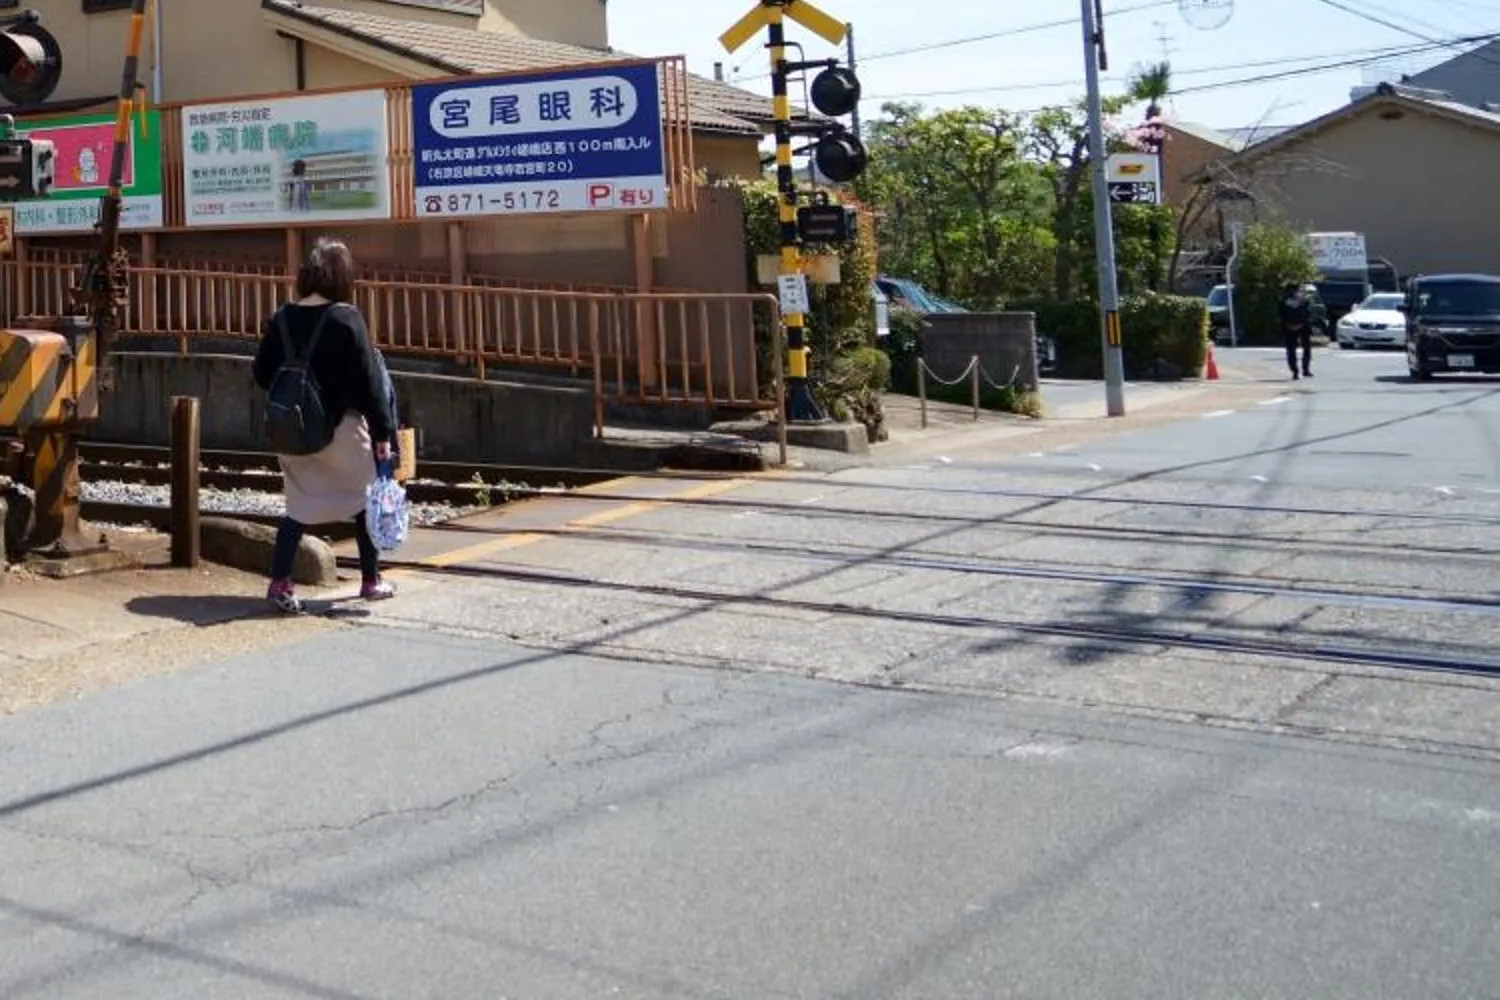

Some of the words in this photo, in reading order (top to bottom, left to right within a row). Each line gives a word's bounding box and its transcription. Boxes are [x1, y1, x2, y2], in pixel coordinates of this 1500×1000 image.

[439, 85, 625, 129] 宮尾眼科
[216, 120, 319, 154] 河端病院
[447, 189, 560, 212] 871-5172
